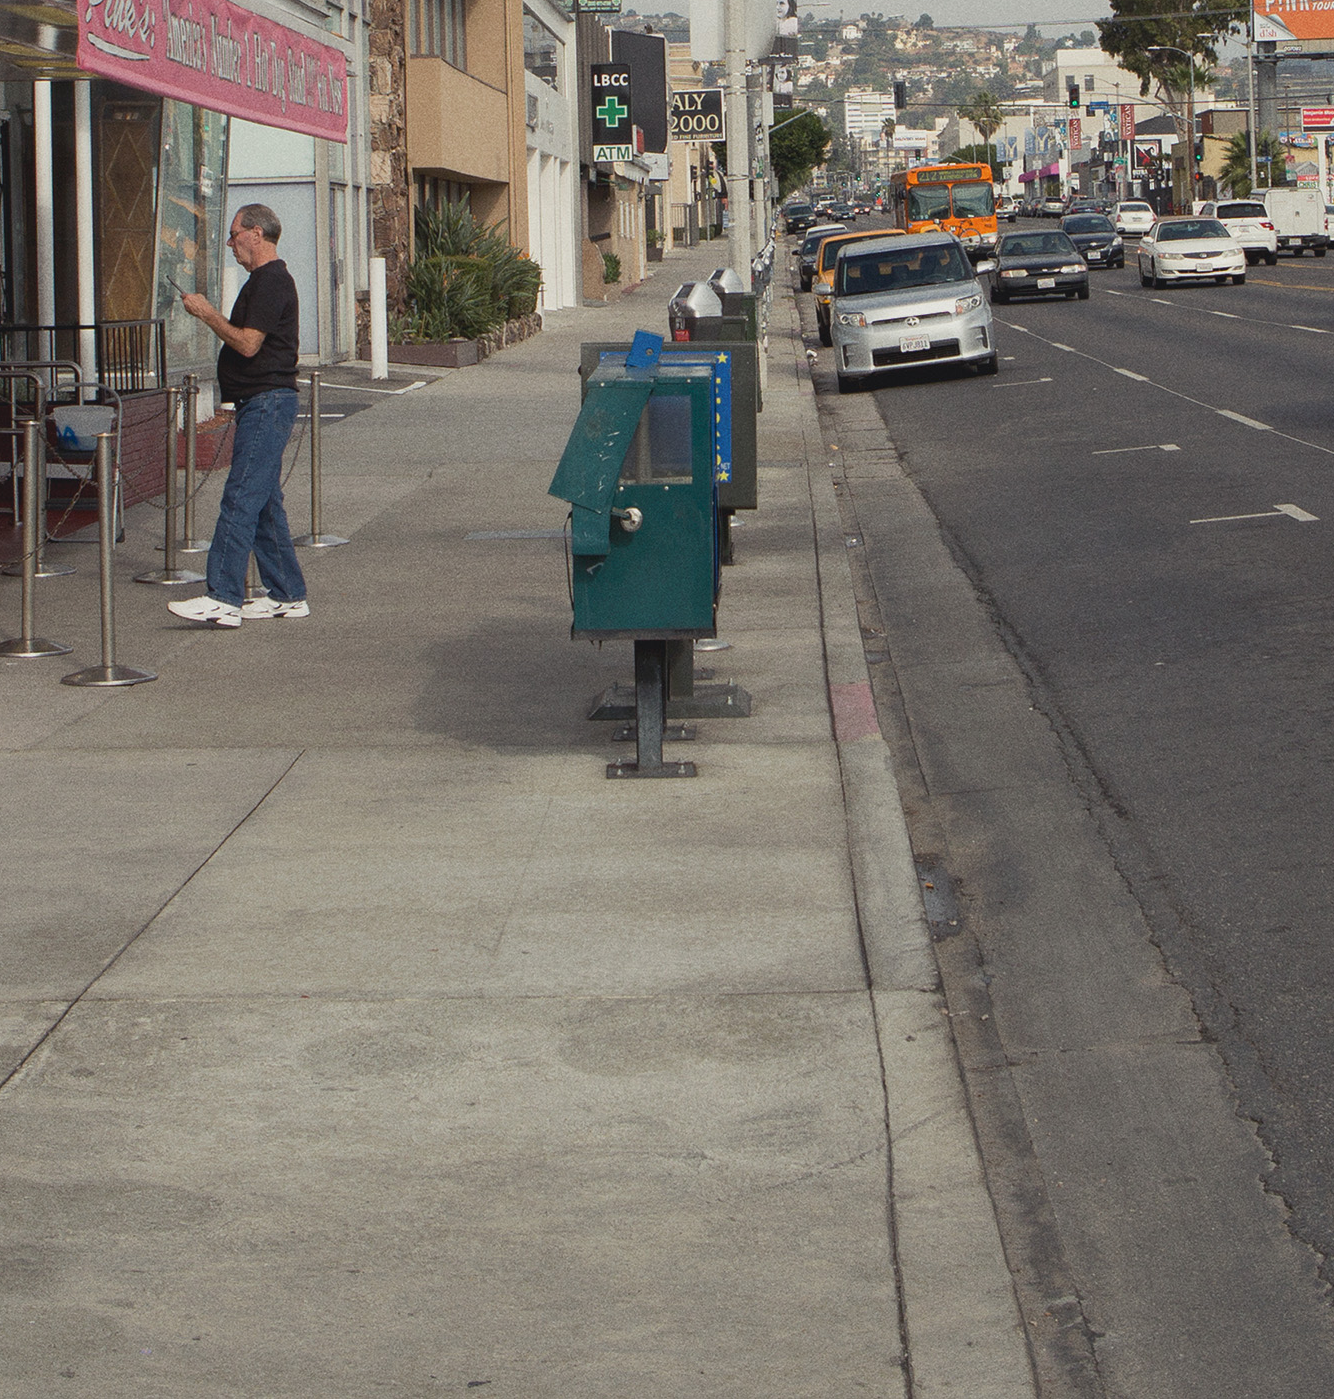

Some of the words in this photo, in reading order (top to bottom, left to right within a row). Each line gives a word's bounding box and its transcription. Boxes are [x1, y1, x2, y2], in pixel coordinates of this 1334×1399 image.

[211, 12, 241, 85] Number
[244, 31, 252, 88] 1
[254, 32, 268, 92] Hot
[270, 41, 286, 114] Dog
[594, 74, 629, 87] LBCC
[671, 114, 720, 133] 2000
[596, 146, 630, 160] ATM
